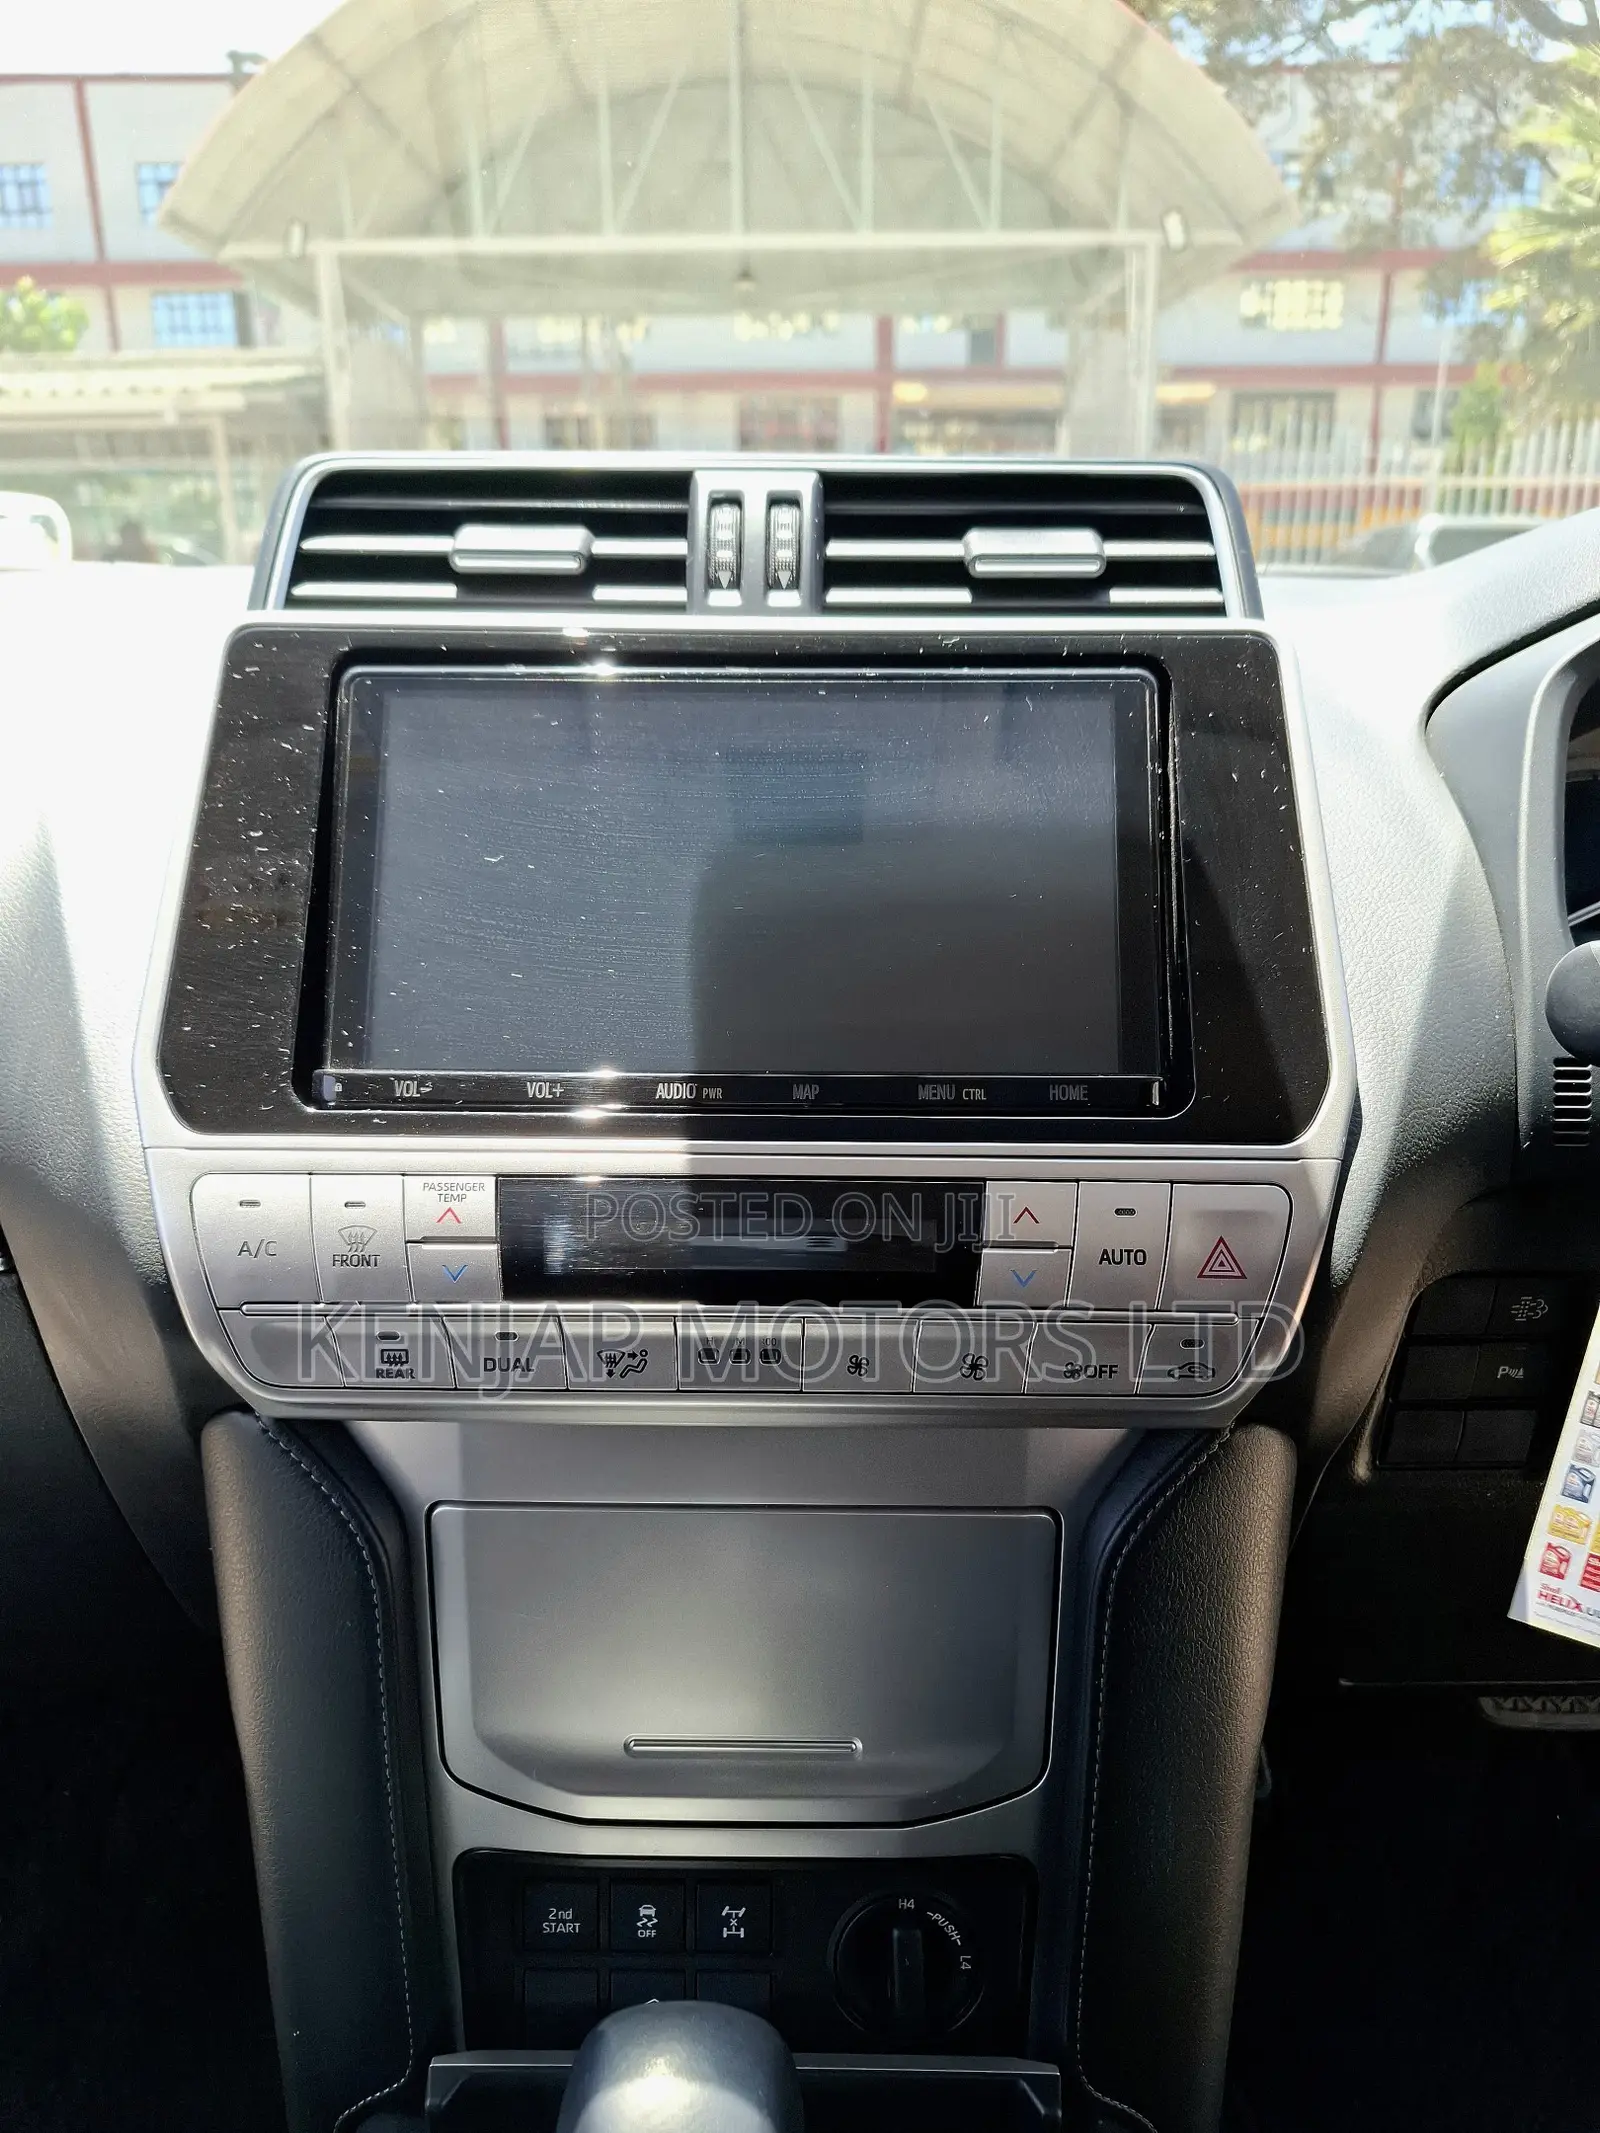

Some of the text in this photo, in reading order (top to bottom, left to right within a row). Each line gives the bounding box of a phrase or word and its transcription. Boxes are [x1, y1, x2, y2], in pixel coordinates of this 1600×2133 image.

[527, 1081, 565, 1098] VOL+
[655, 1082, 723, 1099] AUDIO PWR
[792, 1084, 820, 1099] MAP
[918, 1084, 987, 1100] MENU CTRL
[1050, 1084, 1089, 1100] HOME
[422, 1182, 486, 1192] PASSENGER
[437, 1193, 468, 1203] TEMP
[237, 1239, 278, 1259] A/C
[332, 1254, 380, 1268] FRONT
[1099, 1248, 1147, 1266] AUTO
[483, 1357, 535, 1373] DUAL
[1083, 1364, 1119, 1379] OFF
[375, 1368, 416, 1379] REAR
[898, 1898, 915, 1909] H4
[548, 1908, 573, 1920] 2nd
[542, 1922, 581, 1933] START
[637, 1930, 657, 1938] OFF
[960, 1955, 971, 1969] L4
